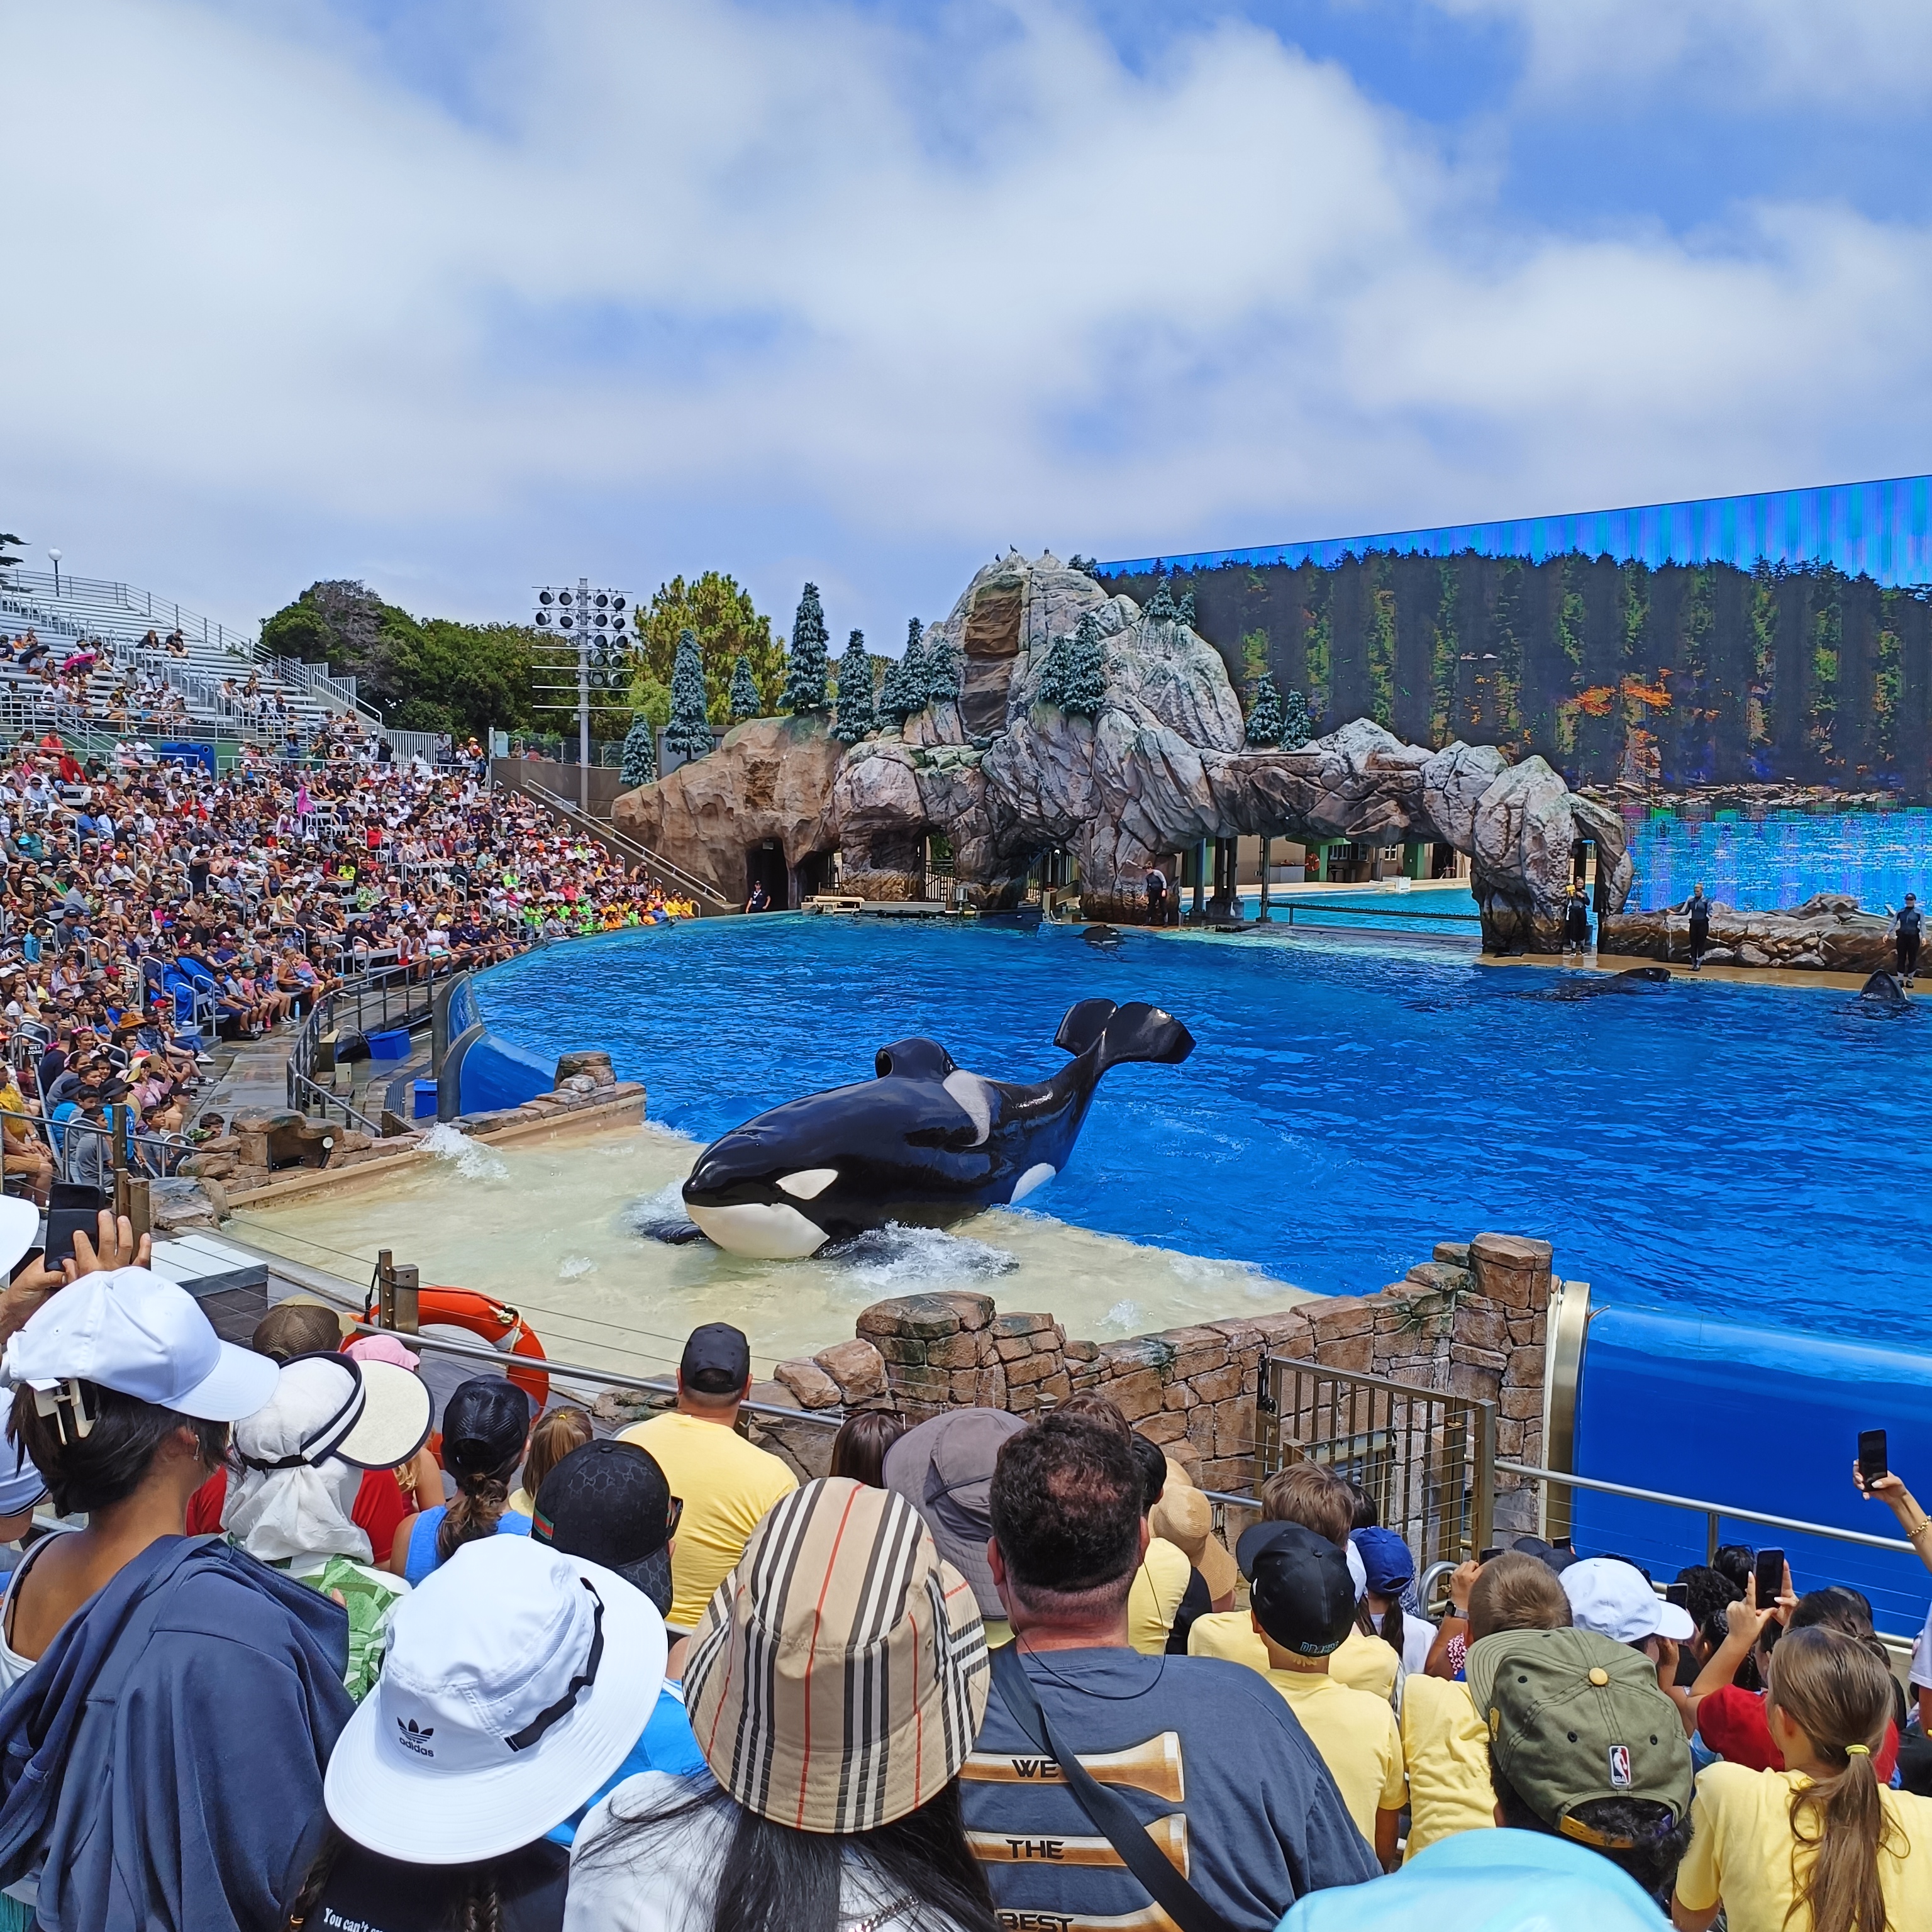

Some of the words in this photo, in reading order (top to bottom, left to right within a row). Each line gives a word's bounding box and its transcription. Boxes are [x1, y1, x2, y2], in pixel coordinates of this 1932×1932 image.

[399, 1737, 434, 1757] adidas
[1011, 1759, 1059, 1778] WE
[1005, 1839, 1065, 1860] THE
[323, 1907, 342, 1928] You
[343, 1919, 369, 1932] can't
[997, 1913, 1074, 1932] BEST
